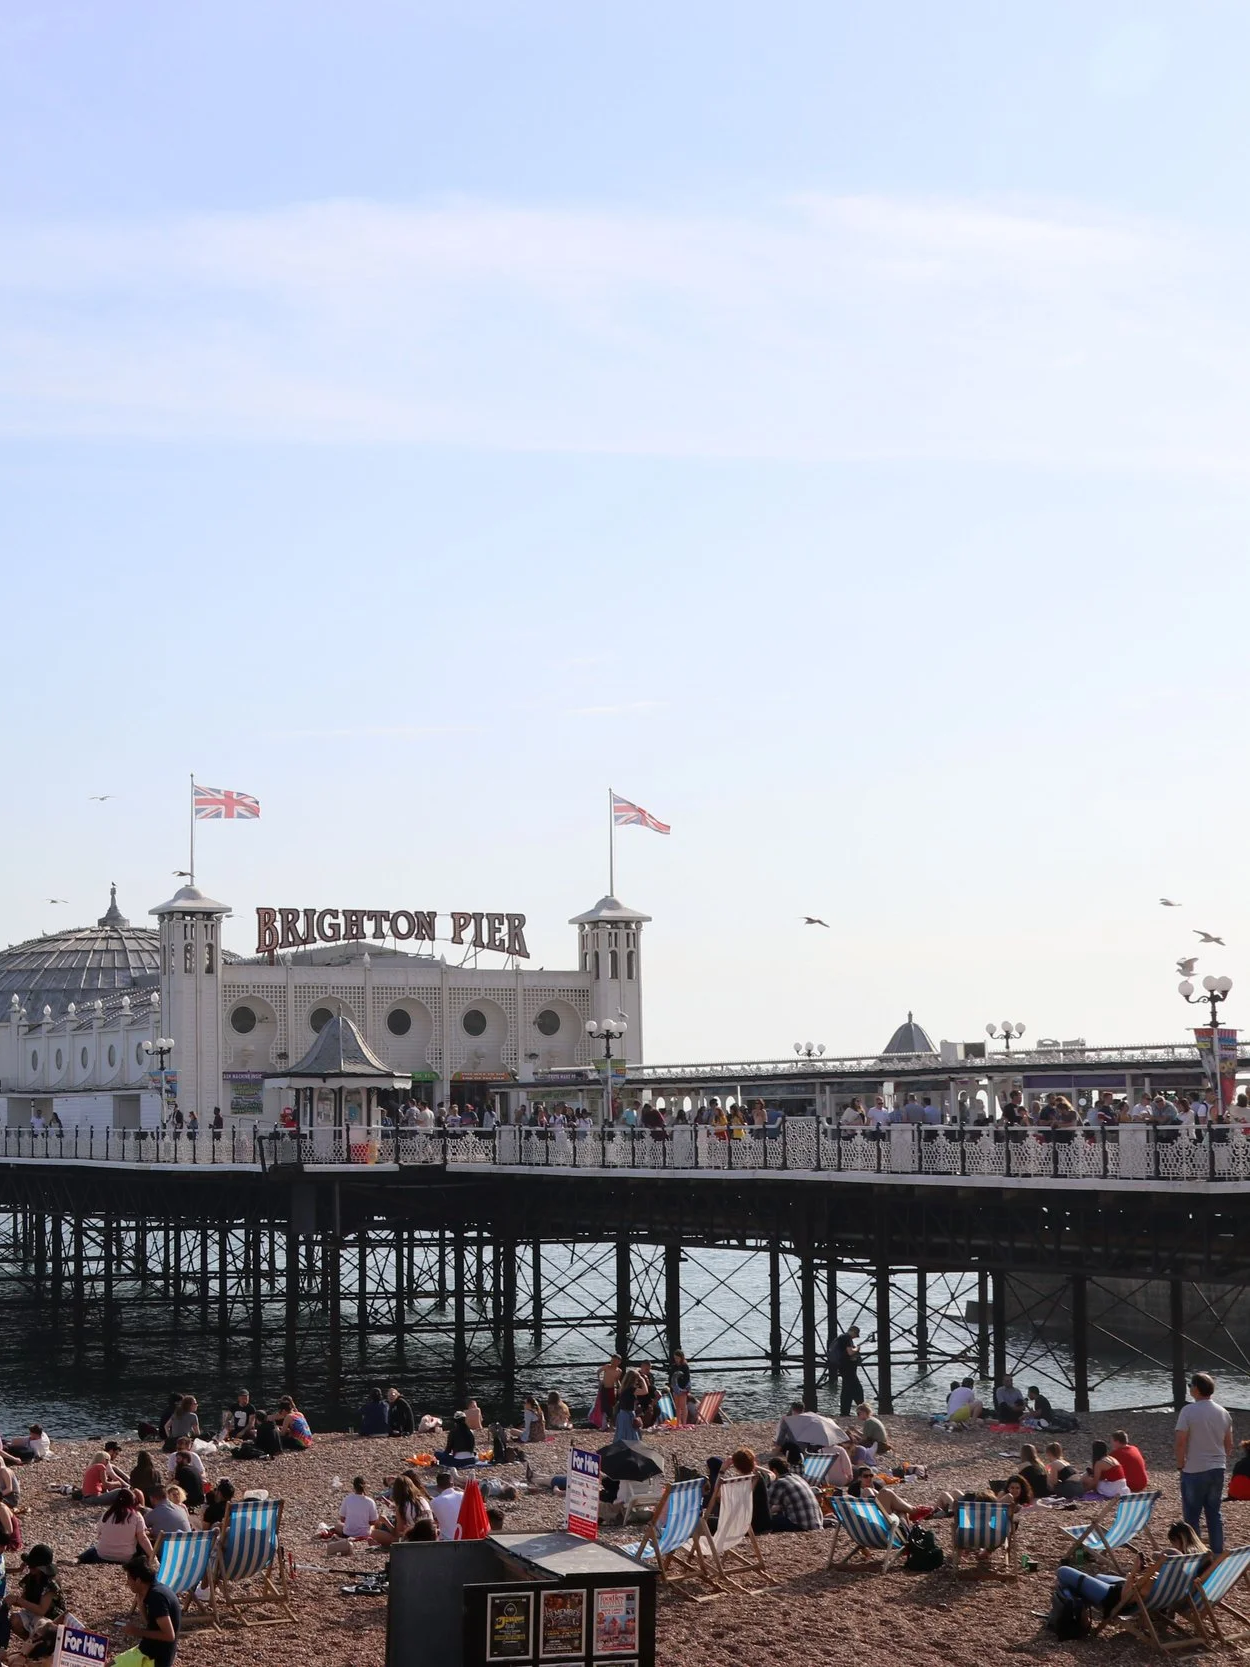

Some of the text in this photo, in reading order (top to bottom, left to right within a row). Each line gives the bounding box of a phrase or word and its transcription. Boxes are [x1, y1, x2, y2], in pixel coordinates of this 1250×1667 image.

[256, 907, 530, 958] BRIGHTON PIER
[572, 1450, 599, 1475] For Hire
[64, 1630, 105, 1658] For Hire
